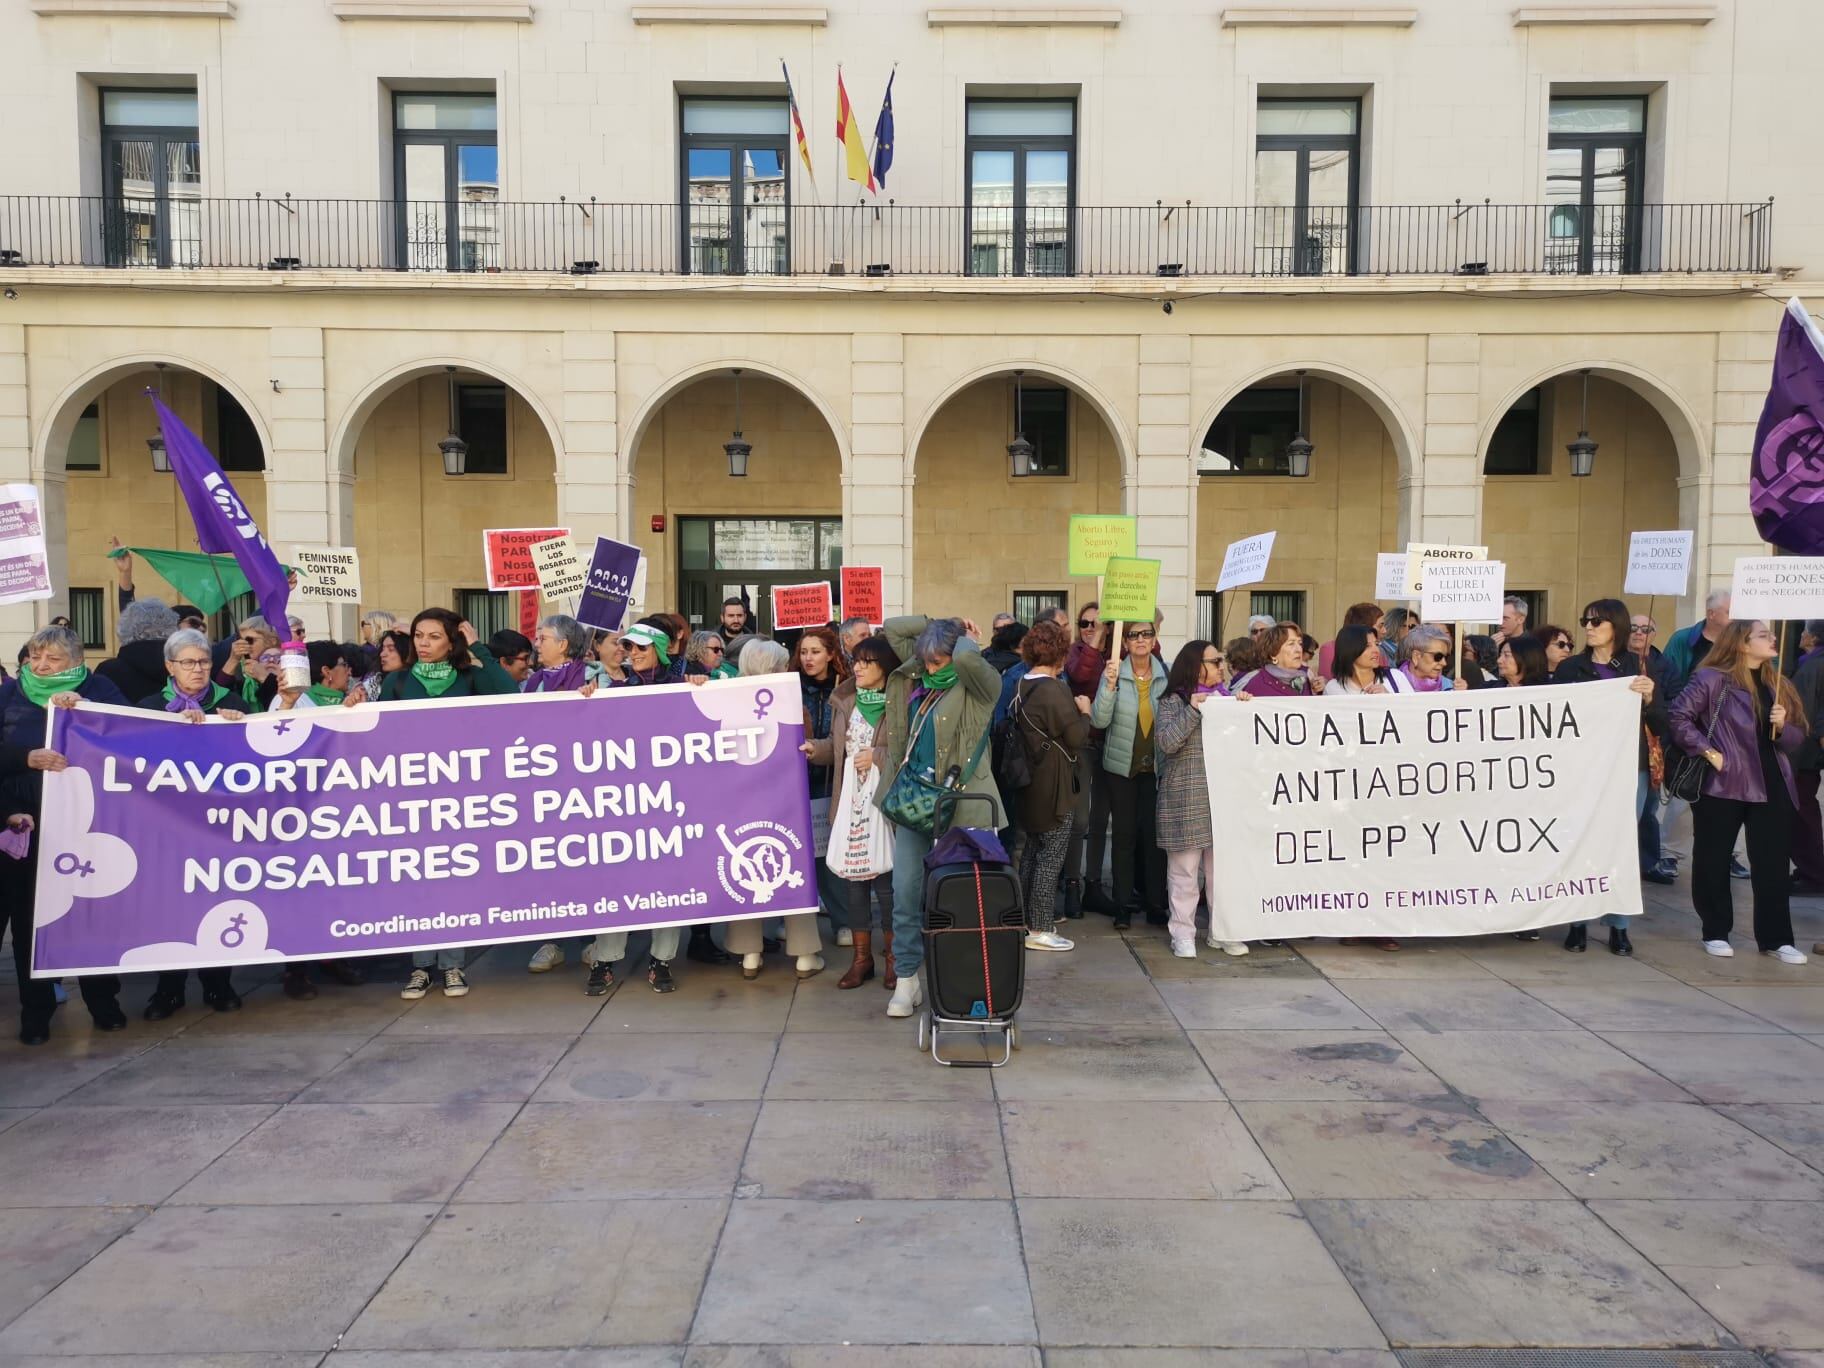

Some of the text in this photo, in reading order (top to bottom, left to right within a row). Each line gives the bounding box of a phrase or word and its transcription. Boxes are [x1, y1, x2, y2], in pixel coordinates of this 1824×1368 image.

[540, 540, 567, 552] FUERA
[1084, 538, 1113, 547] Seguro
[1232, 540, 1262, 558] FUERA
[1424, 549, 1474, 560] ABORTO
[1650, 547, 1682, 558] DONES
[298, 552, 354, 564] FEMINISME
[547, 551, 564, 560] LOS
[307, 564, 348, 575] CONTRA
[503, 560, 535, 570] Noso
[538, 557, 577, 572] ROSARIOS
[1756, 563, 1787, 571] DRETS
[555, 569, 565, 577] DE
[1428, 565, 1497, 577] MATERNITAT
[319, 575, 337, 586] LES
[543, 574, 583, 589] NUESTROS
[848, 580, 876, 588] toquen
[1119, 581, 1147, 589] derechos
[1439, 580, 1476, 590] LLIURE
[302, 585, 358, 598] OPRESIONS
[546, 583, 584, 598] OVARIOS
[783, 588, 821, 597] Nosotras
[855, 587, 875, 596] UNA,
[1741, 588, 1758, 596] NO
[1771, 588, 1824, 596] NEGOCIE
[783, 596, 822, 606] PARIMOS
[1432, 592, 1492, 603] DESITJADA
[784, 607, 822, 616] Nosotras
[848, 605, 876, 613] toquen
[1113, 603, 1138, 613] mujeres
[779, 614, 827, 625] DECIDIMOS
[1253, 700, 1582, 747] NO A LA OFICINA
[103, 727, 766, 793] L'AVORTAMENT ÉS UN DRET
[1272, 754, 1556, 806] ANTIABORTOS
[206, 780, 687, 842] "NOSALTRES PARIM,
[734, 820, 774, 836] FEMINISTA
[1275, 818, 1561, 865] DEL PP Y VOX
[183, 823, 704, 893] NOSALTRES DECIDIM"
[1260, 875, 1611, 914] MOVIMIENTO FEMINISTA ALICANTE
[329, 887, 708, 938] Coordinadora Feminista de València
